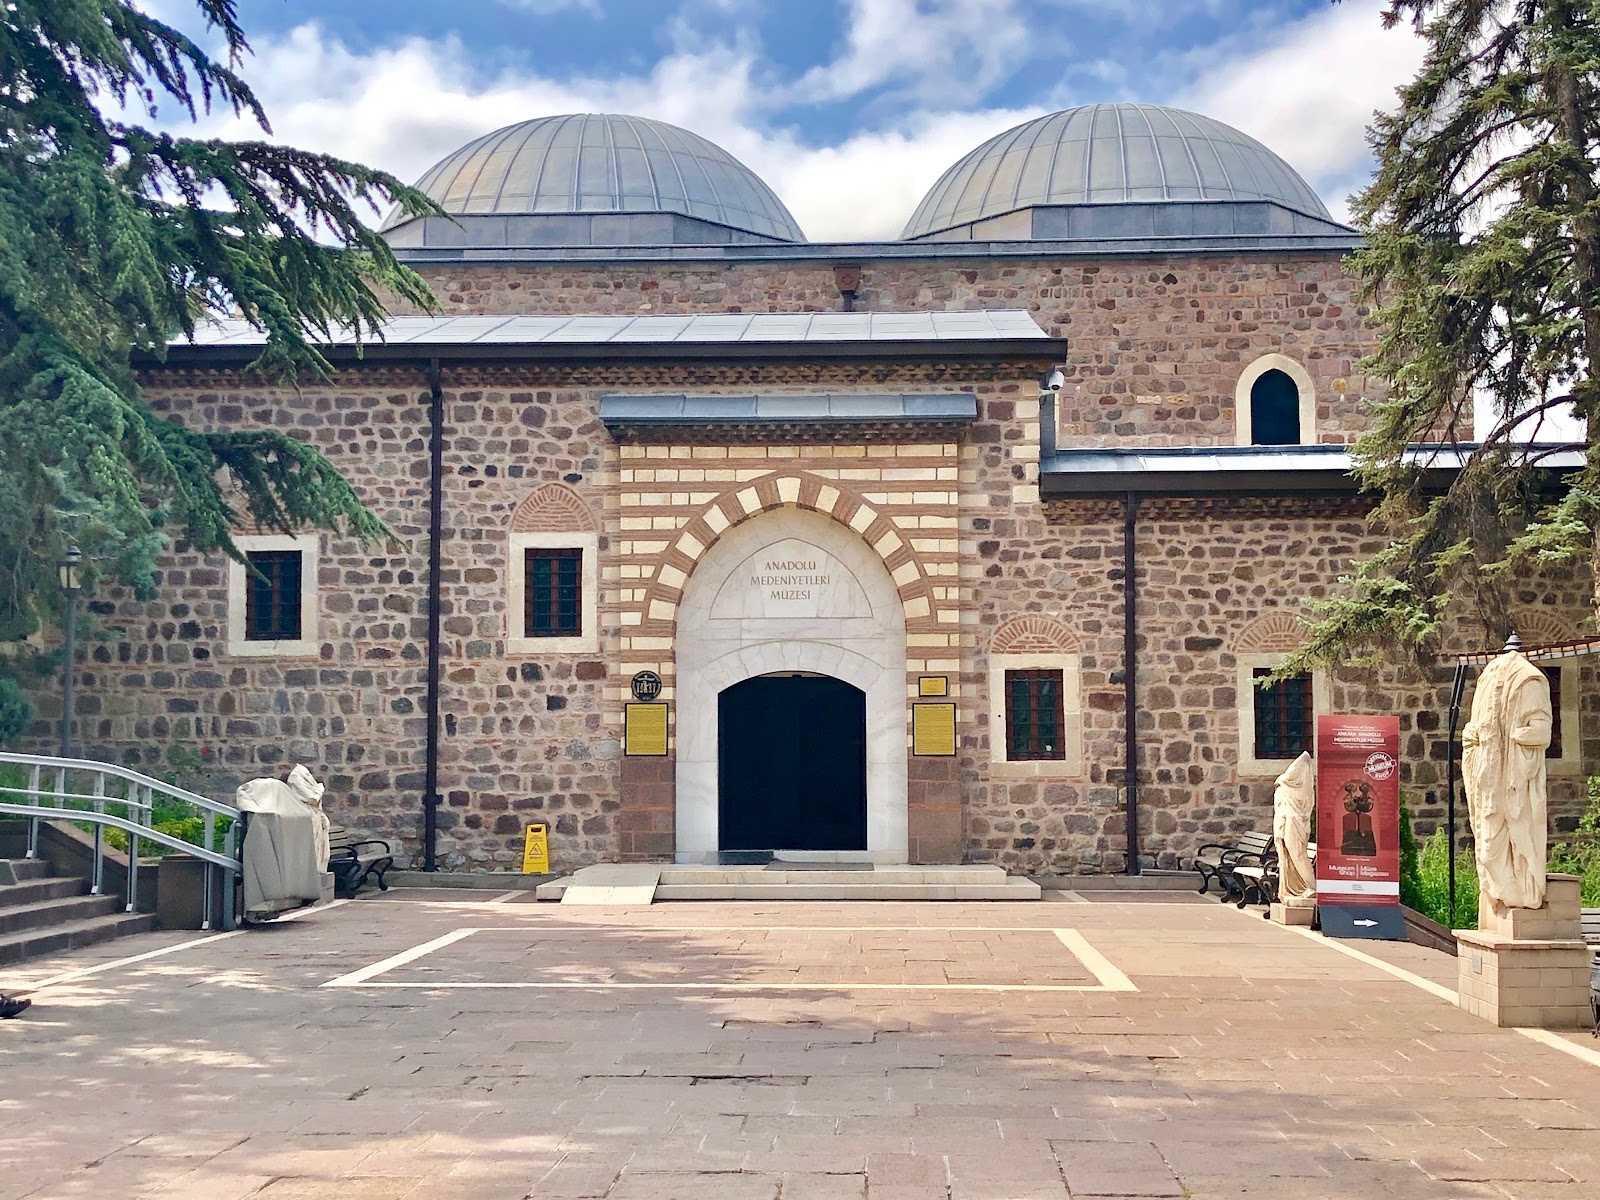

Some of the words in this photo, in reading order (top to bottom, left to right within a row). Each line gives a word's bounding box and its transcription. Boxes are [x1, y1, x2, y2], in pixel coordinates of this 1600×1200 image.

[764, 560, 817, 571] ANADOLU
[750, 574, 831, 586] MEDENİYETLERİ
[770, 589, 812, 600] MÜZESİ
[1367, 753, 1388, 765] OFFICIAL
[1368, 760, 1392, 773] MUSEUM
[1374, 770, 1390, 779] SHOP
